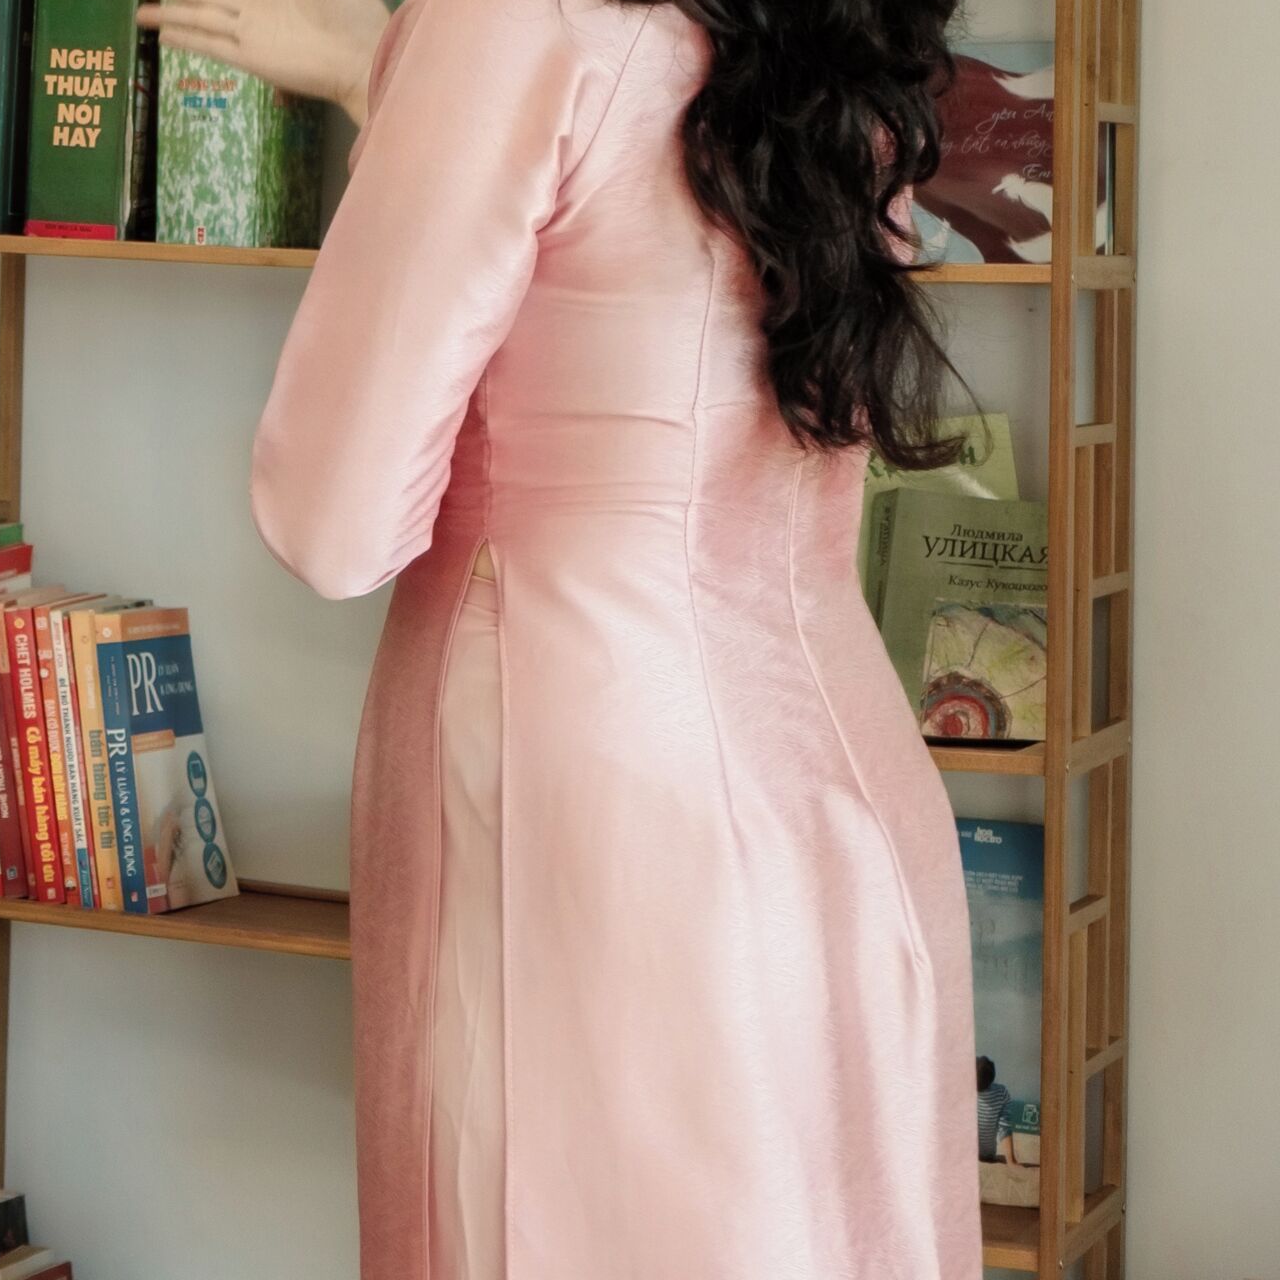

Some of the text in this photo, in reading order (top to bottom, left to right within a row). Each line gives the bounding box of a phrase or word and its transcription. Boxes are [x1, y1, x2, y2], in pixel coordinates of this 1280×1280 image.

[50, 47, 115, 75] NGHỆ
[44, 73, 117, 101] THUẬT
[57, 101, 101, 126] NÓI
[52, 126, 101, 148] HAY
[950, 523, 1024, 542] Людмила
[922, 535, 1048, 565] УЛИЦКАЯ
[948, 574, 983, 589] Казус
[15, 633, 30, 666] CHET
[18, 667, 37, 719] HOLMES
[126, 651, 165, 716] PR
[62, 707, 73, 734] THÀNH
[70, 781, 80, 805] HÀNG
[88, 729, 104, 758] bán
[106, 727, 127, 758] PR
[114, 760, 126, 773] LÝ
[31, 776, 49, 803] bán
[34, 805, 53, 841] hàng
[120, 807, 130, 816] &
[123, 844, 137, 877] DỤNG
